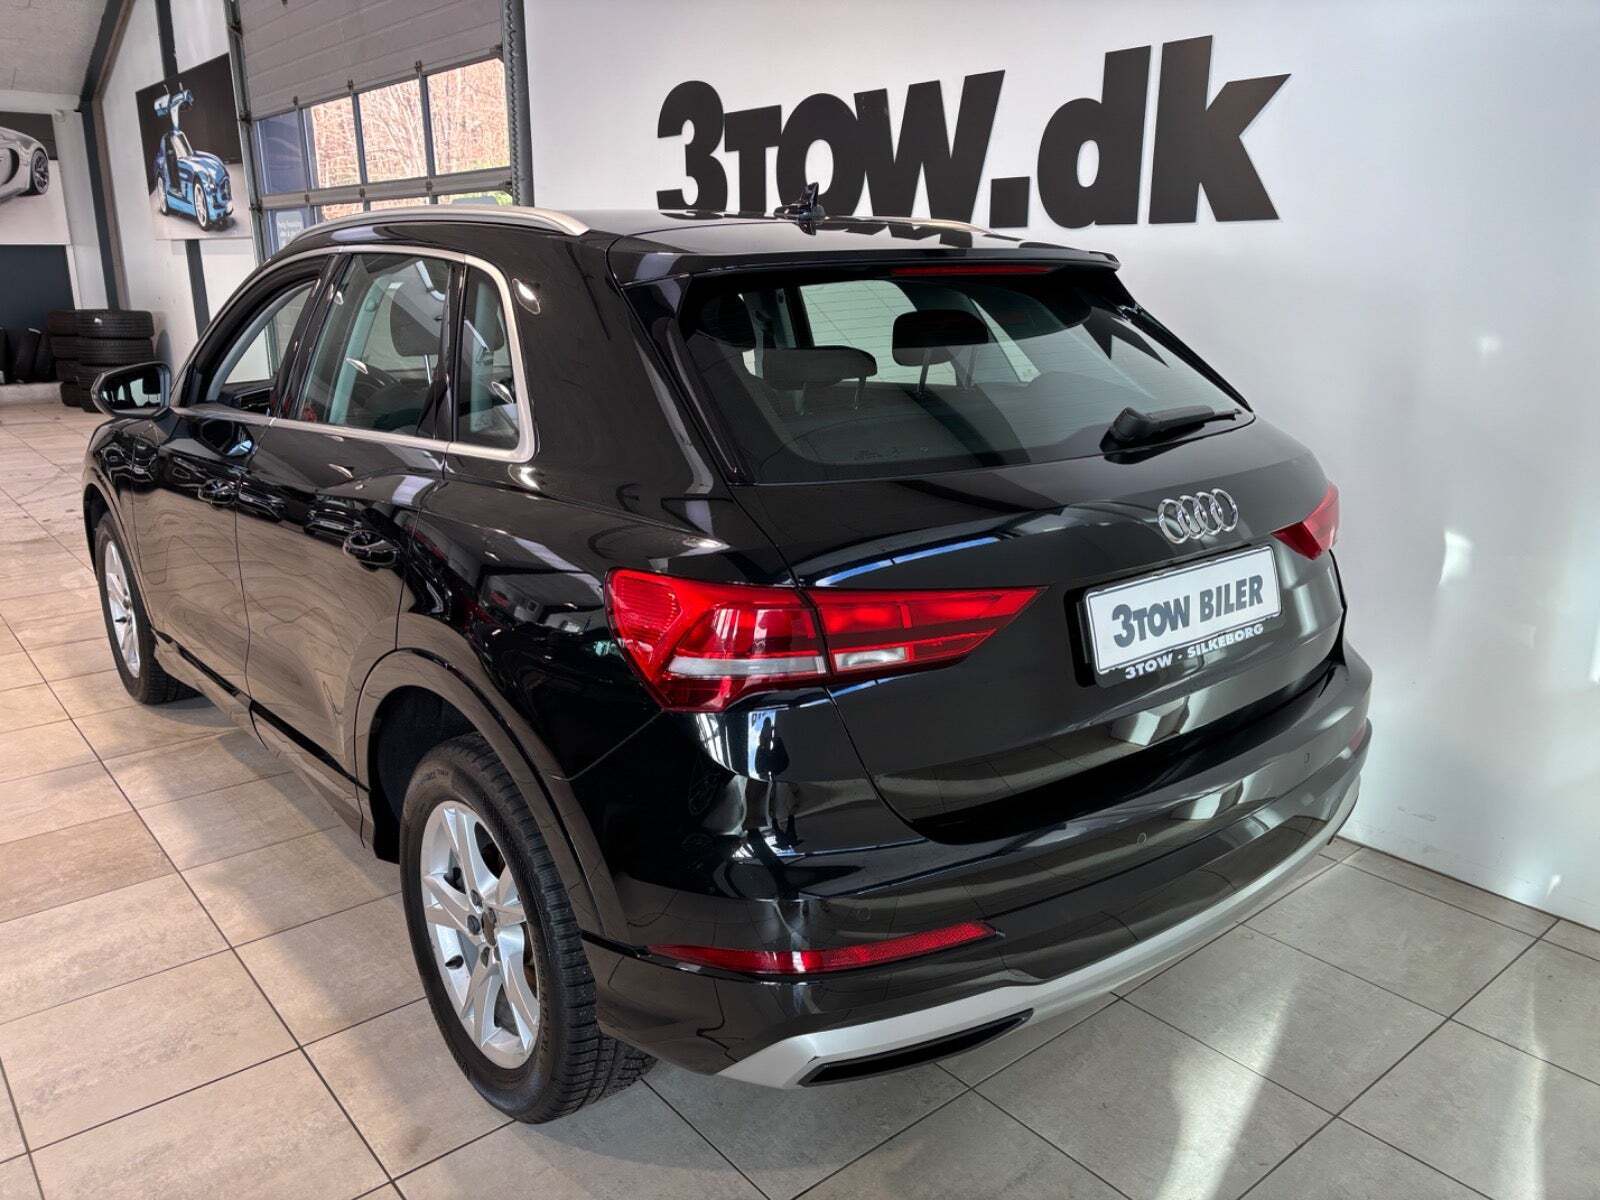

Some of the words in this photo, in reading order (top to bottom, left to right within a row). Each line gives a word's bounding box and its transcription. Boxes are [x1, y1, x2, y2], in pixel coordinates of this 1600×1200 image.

[657, 35, 1291, 228] 3TOW.dk
[1112, 595, 1191, 648] 3TOW
[1200, 574, 1264, 623] BILER
[1125, 653, 1173, 679] 3TOW
[1187, 623, 1264, 658] SILKEBORG
